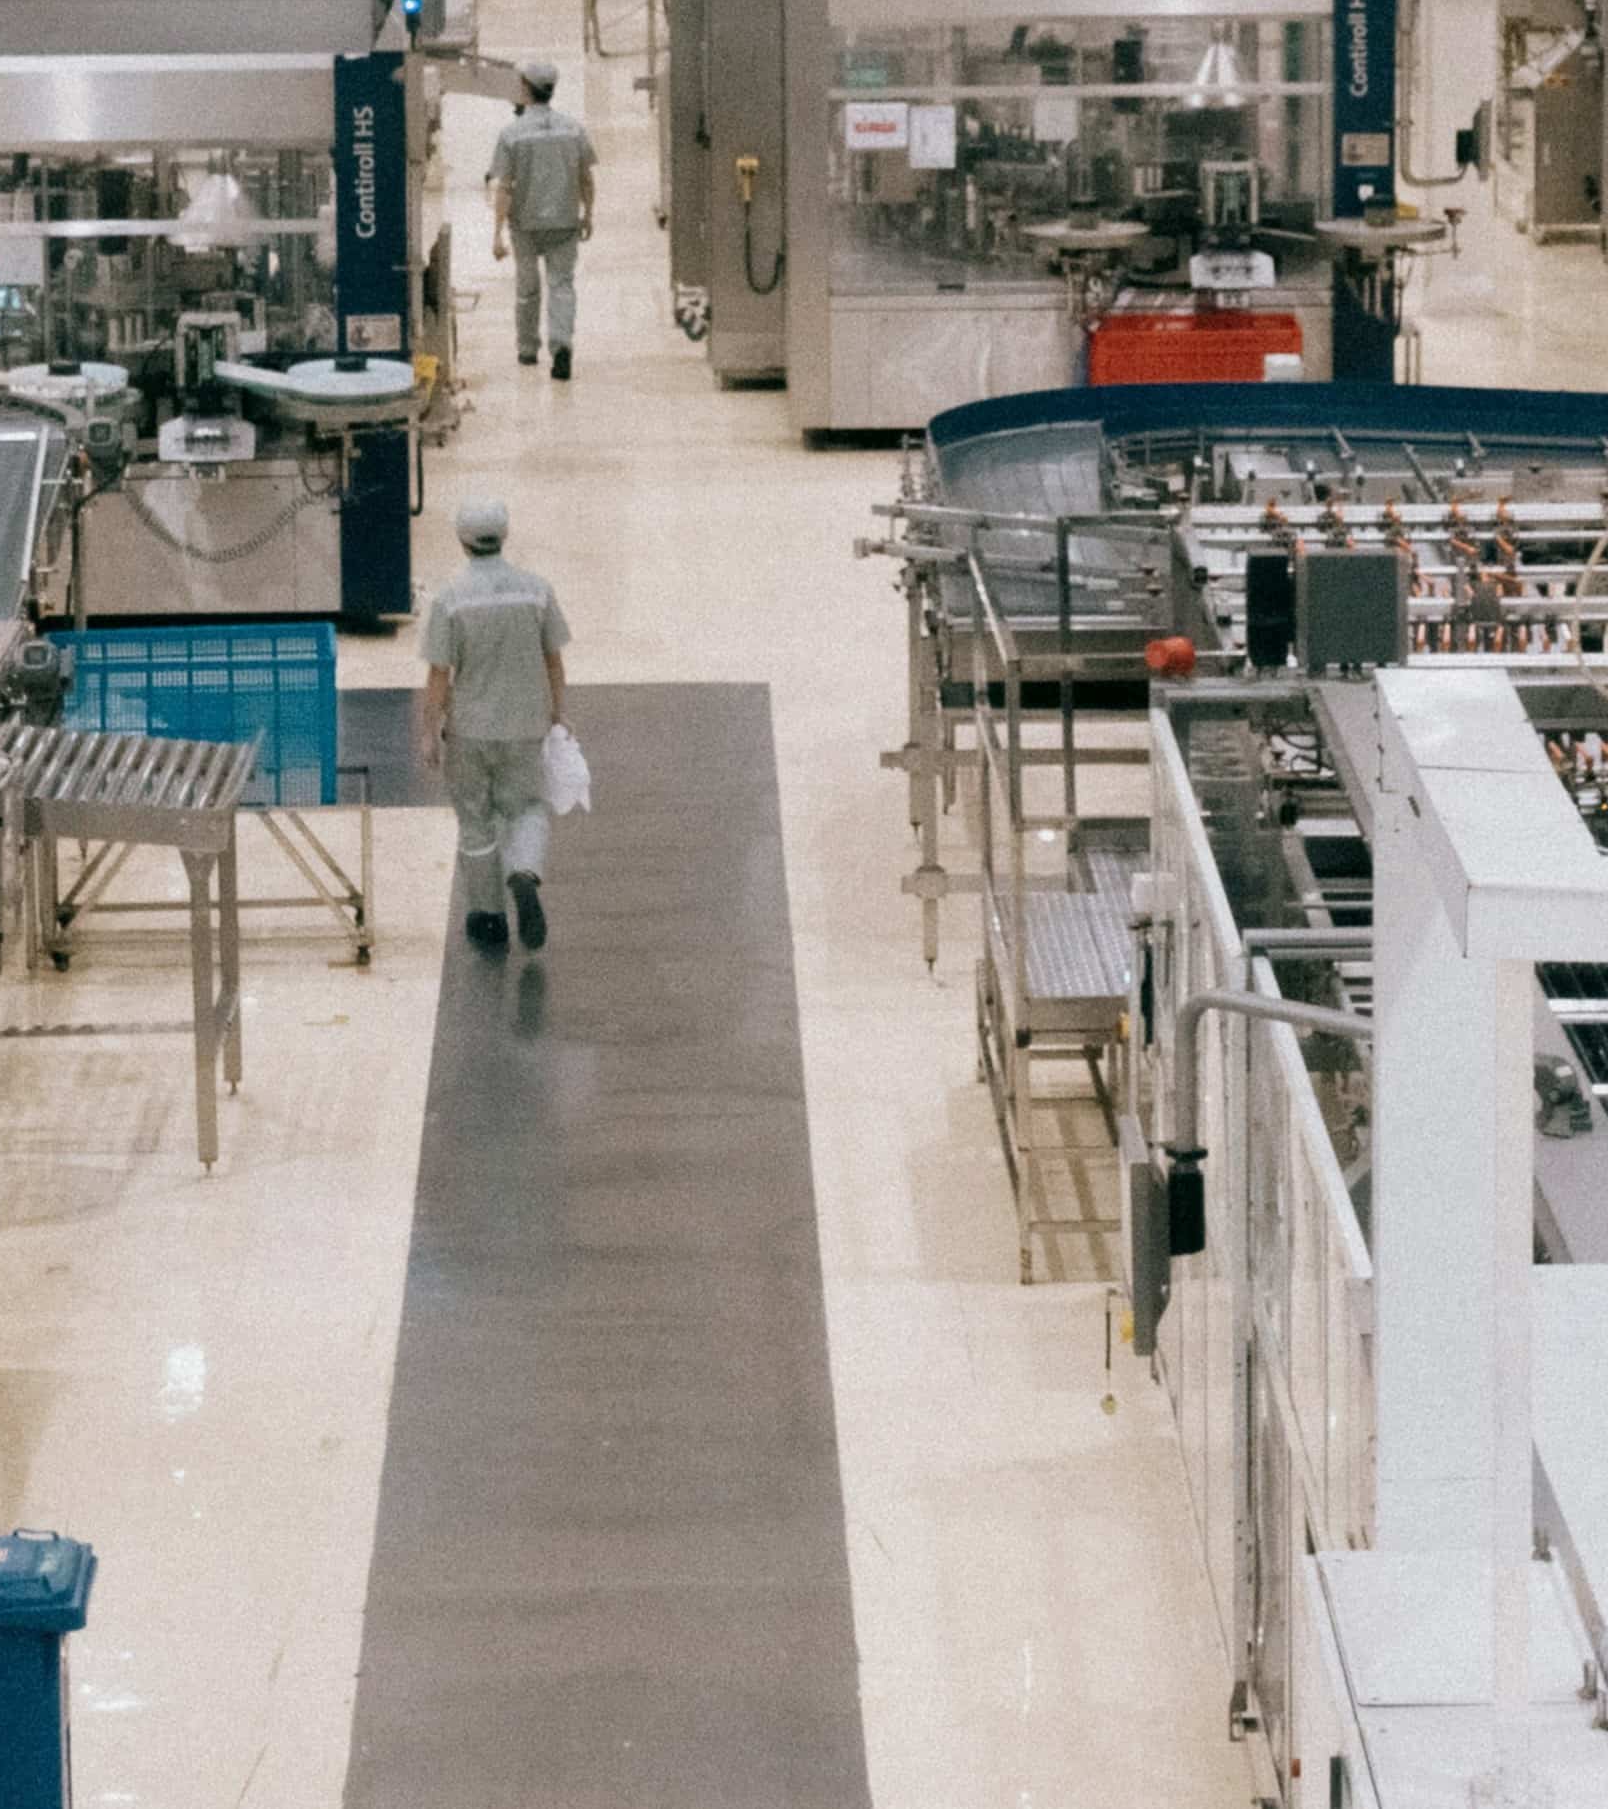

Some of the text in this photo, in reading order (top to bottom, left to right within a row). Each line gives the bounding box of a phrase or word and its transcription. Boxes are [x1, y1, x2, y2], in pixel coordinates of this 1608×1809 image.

[1347, 13, 1369, 97] Contiroll
[352, 105, 376, 238] Contiroll HS
